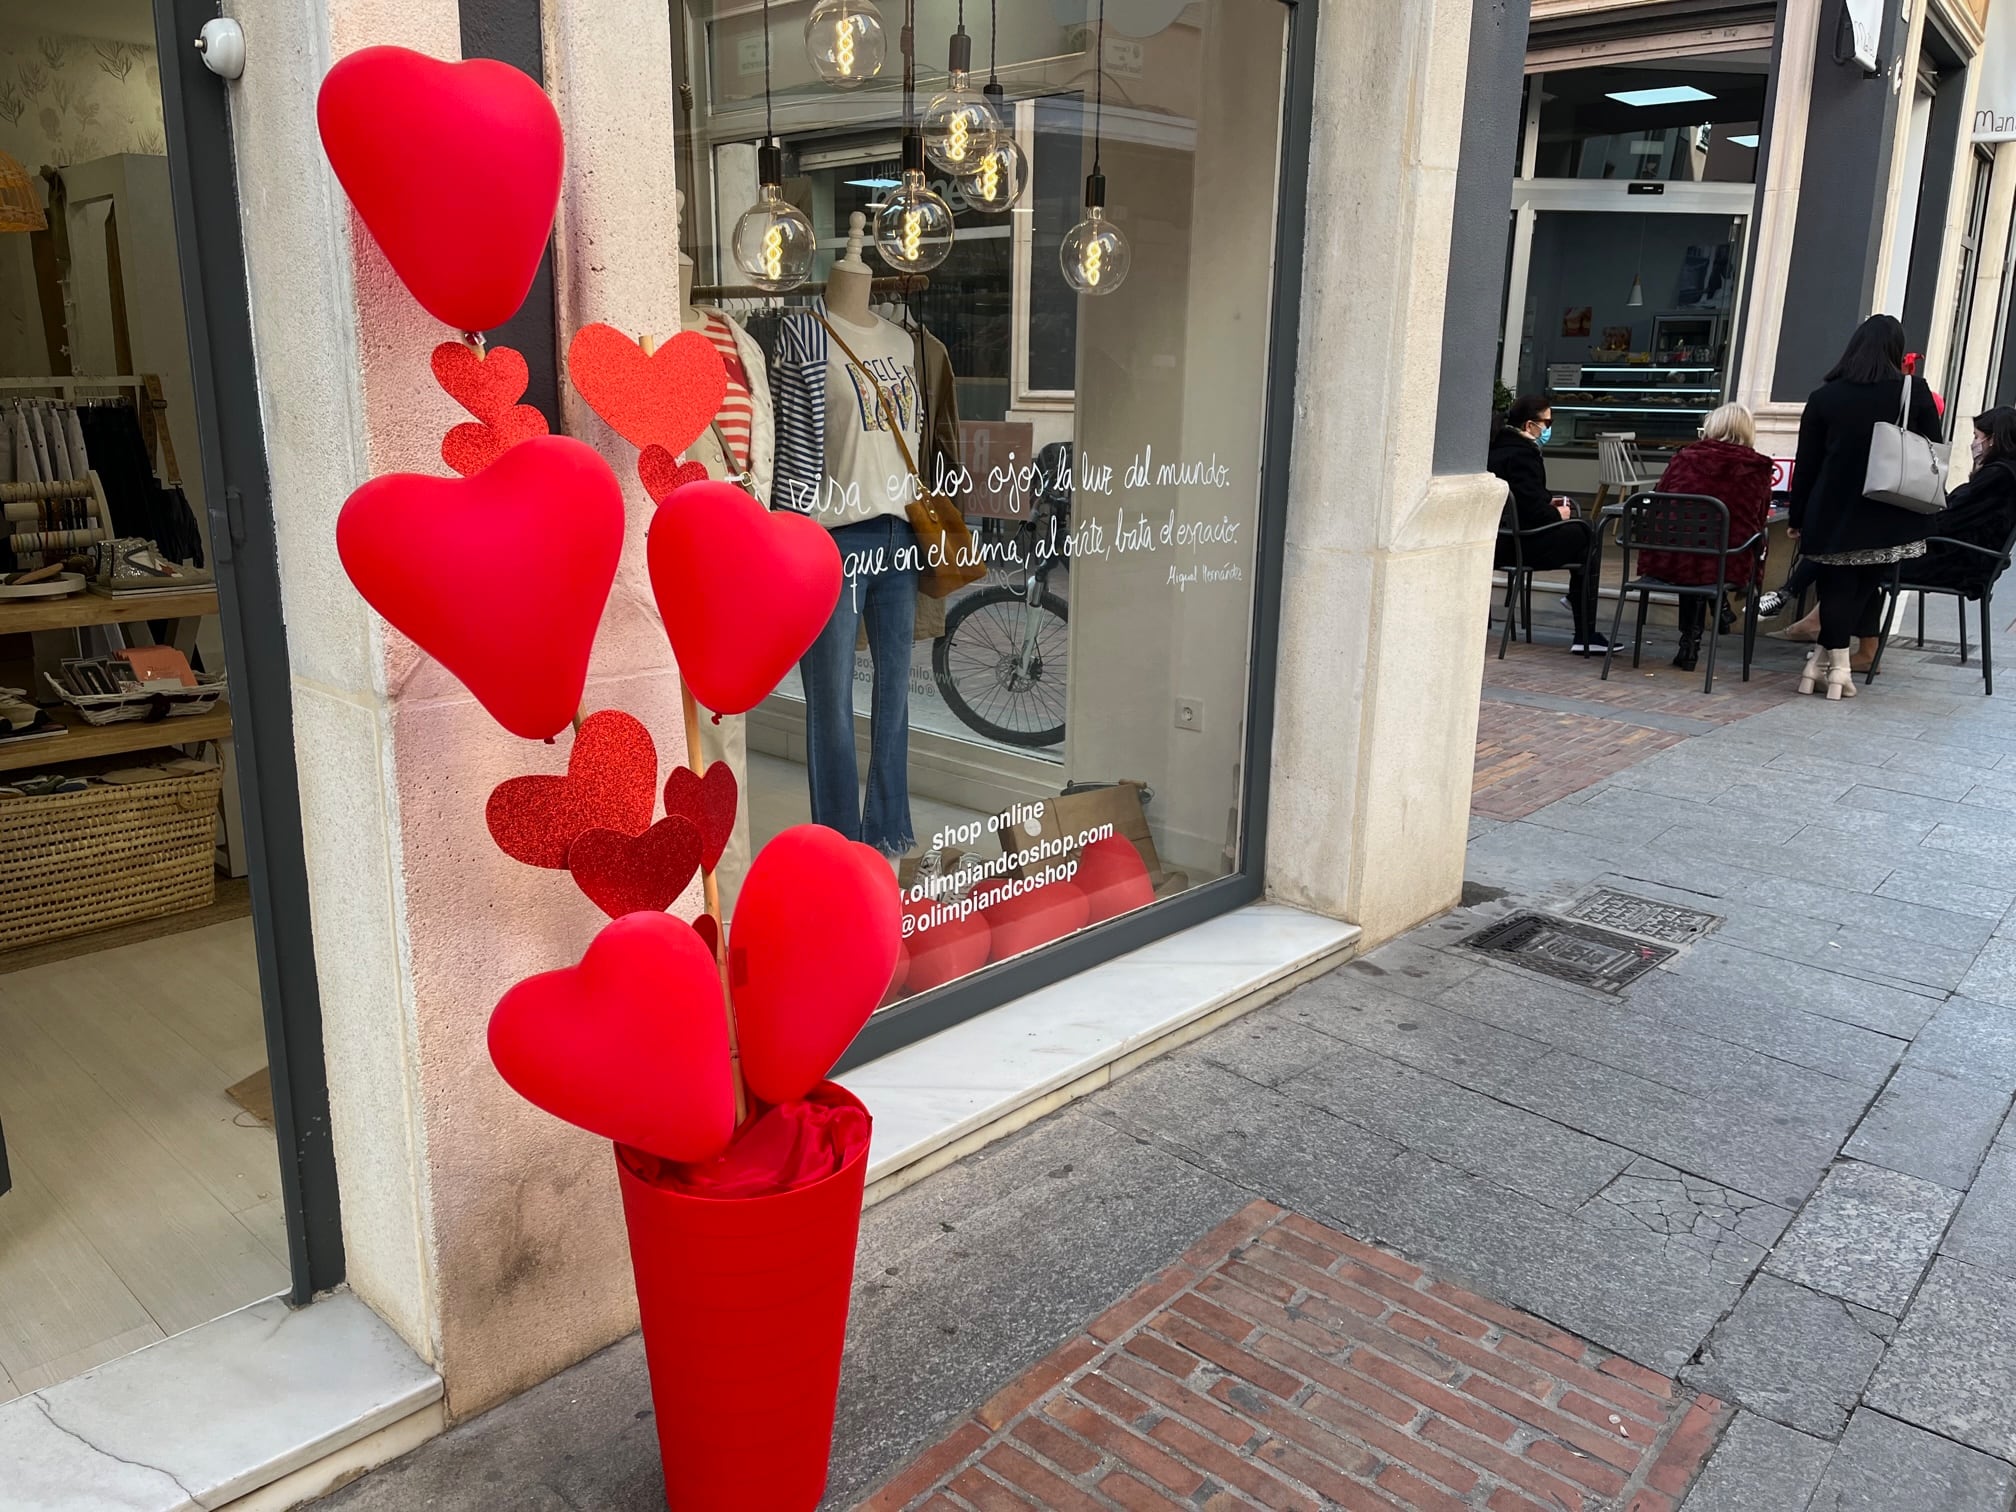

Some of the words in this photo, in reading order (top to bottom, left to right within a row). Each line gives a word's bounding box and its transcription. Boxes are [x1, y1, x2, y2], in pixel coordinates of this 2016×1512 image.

[1973, 110, 2016, 133] Man
[863, 357, 902, 383] SELF
[788, 473, 871, 515] risa
[886, 472, 922, 501] en
[931, 451, 973, 497] los
[988, 452, 1044, 513] ojos
[1053, 446, 1076, 491] la
[1082, 451, 1112, 495] luz
[1124, 444, 1151, 489] del
[1156, 452, 1230, 488] mundo.
[843, 547, 888, 614] que
[894, 545, 924, 571] en
[928, 529, 949, 567] el
[956, 530, 1030, 569] alma,
[1035, 515, 1058, 559] al
[1160, 509, 1174, 546] el
[1176, 515, 1240, 555] espacio.
[1166, 565, 1198, 592] Miguel
[932, 821, 982, 850] shop
[987, 801, 1044, 833] online
[902, 860, 1078, 938] @olimpiandcoshop
